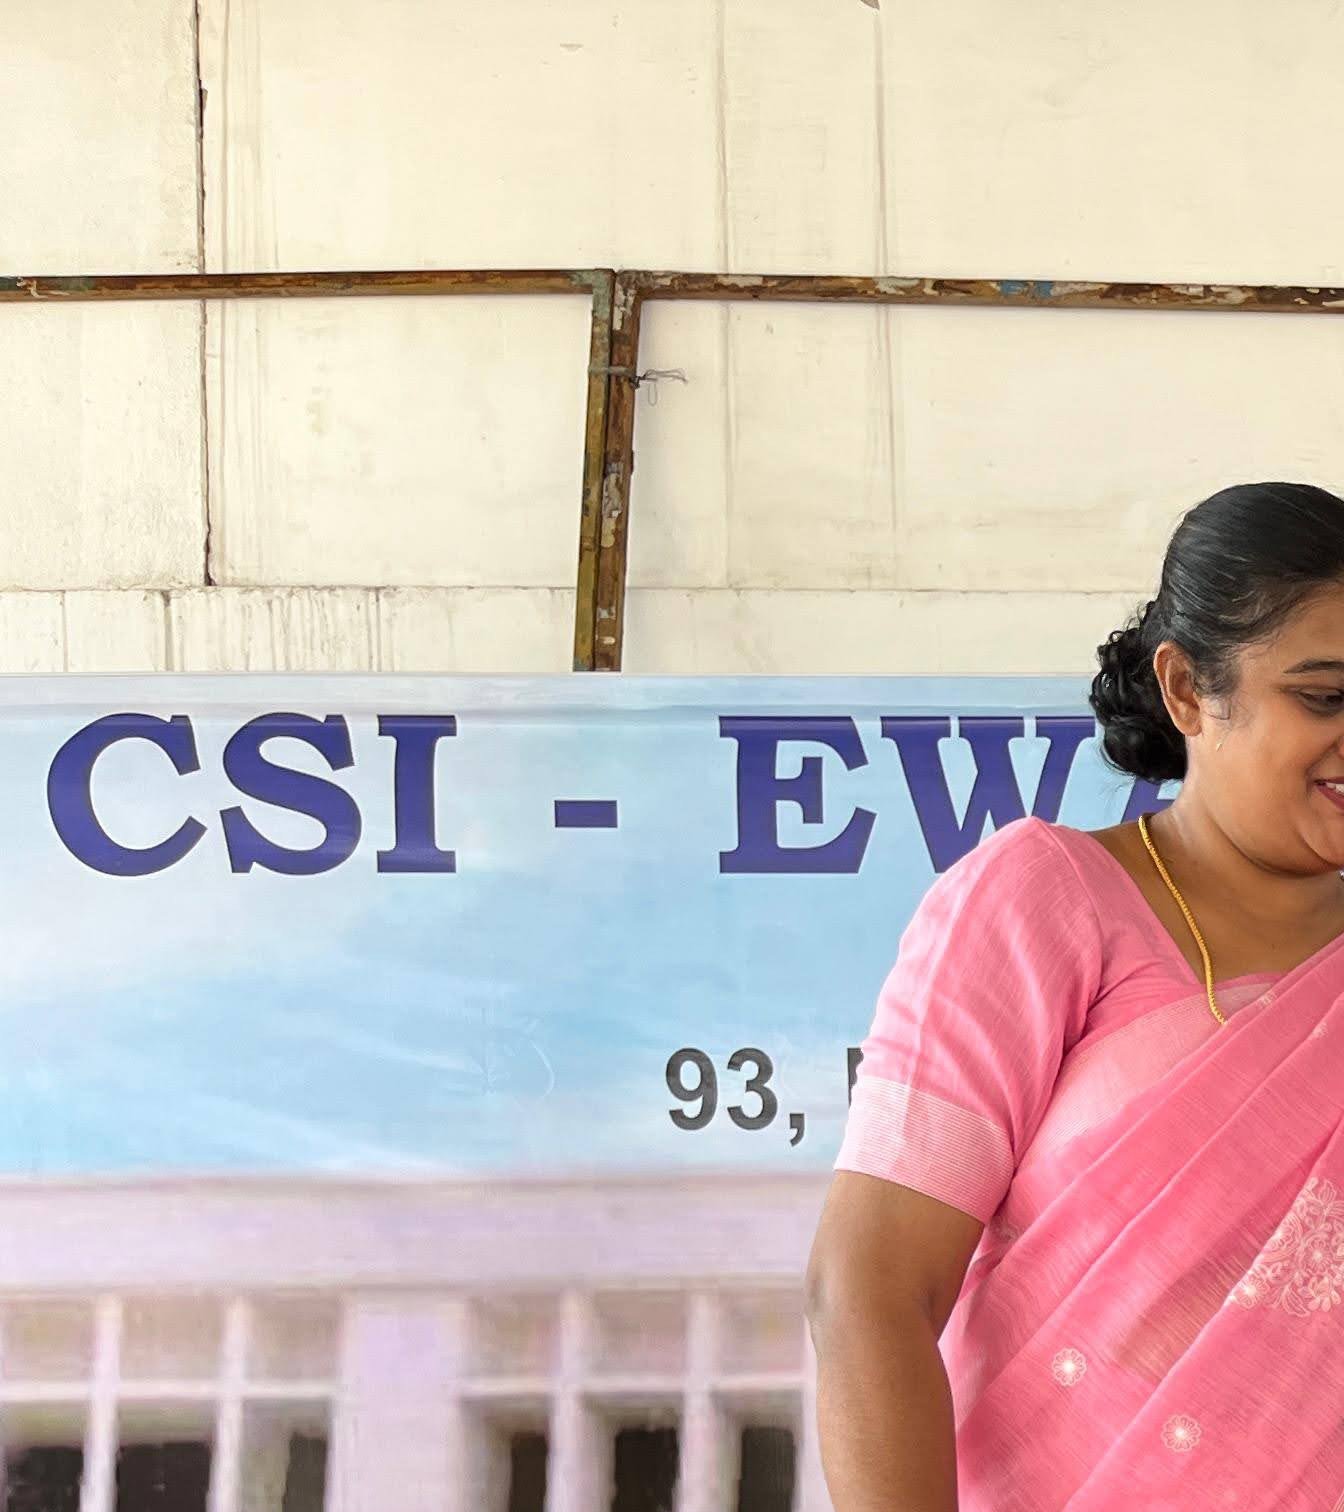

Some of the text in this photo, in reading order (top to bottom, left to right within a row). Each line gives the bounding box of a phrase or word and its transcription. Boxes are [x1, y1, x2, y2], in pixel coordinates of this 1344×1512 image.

[47, 712, 457, 876] CSI
[554, 801, 618, 828] -
[665, 1047, 807, 1146] 93,
